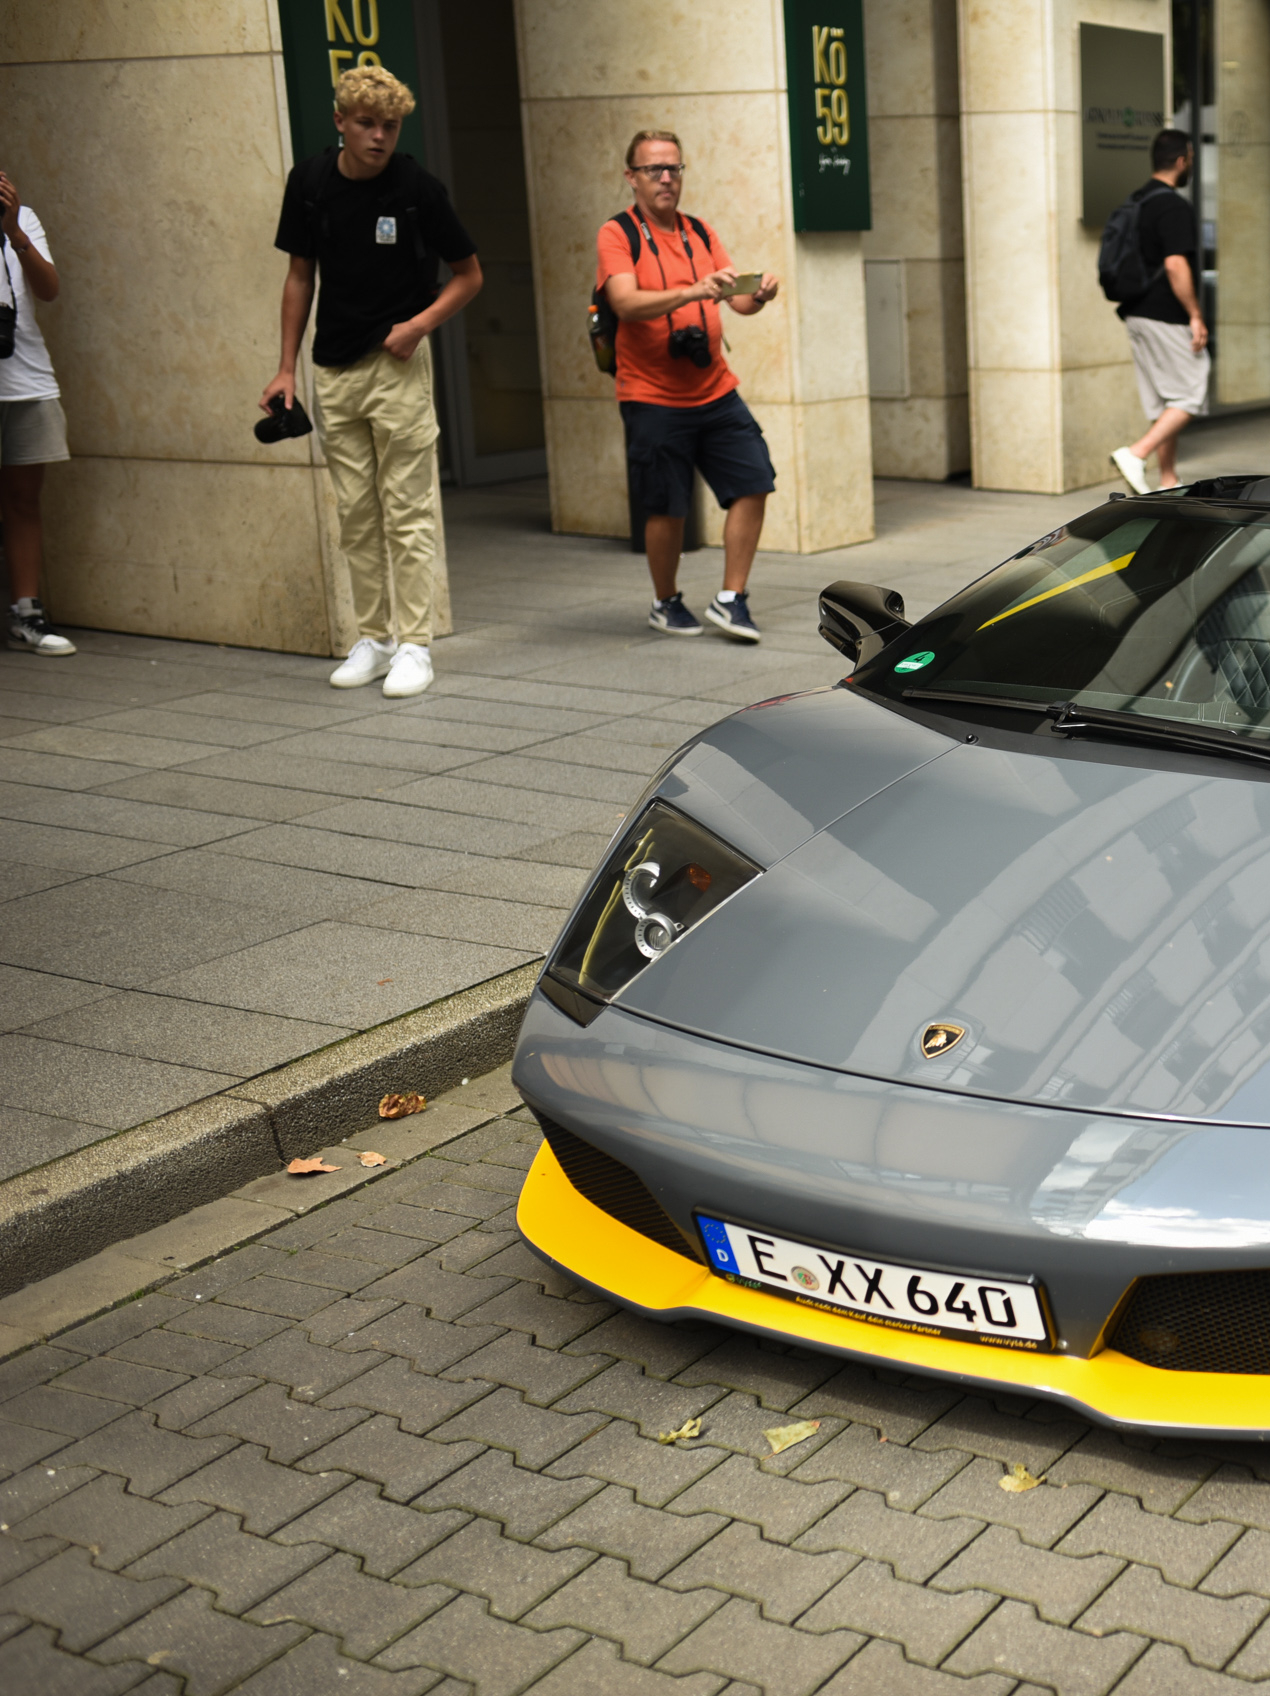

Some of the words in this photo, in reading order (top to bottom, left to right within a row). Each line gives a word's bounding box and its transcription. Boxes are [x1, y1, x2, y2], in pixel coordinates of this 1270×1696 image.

[815, 88, 851, 146] 59
[716, 1248, 729, 1262] D
[747, 1234, 788, 1281] E
[817, 1254, 895, 1310] XX
[907, 1275, 1017, 1327] 640
